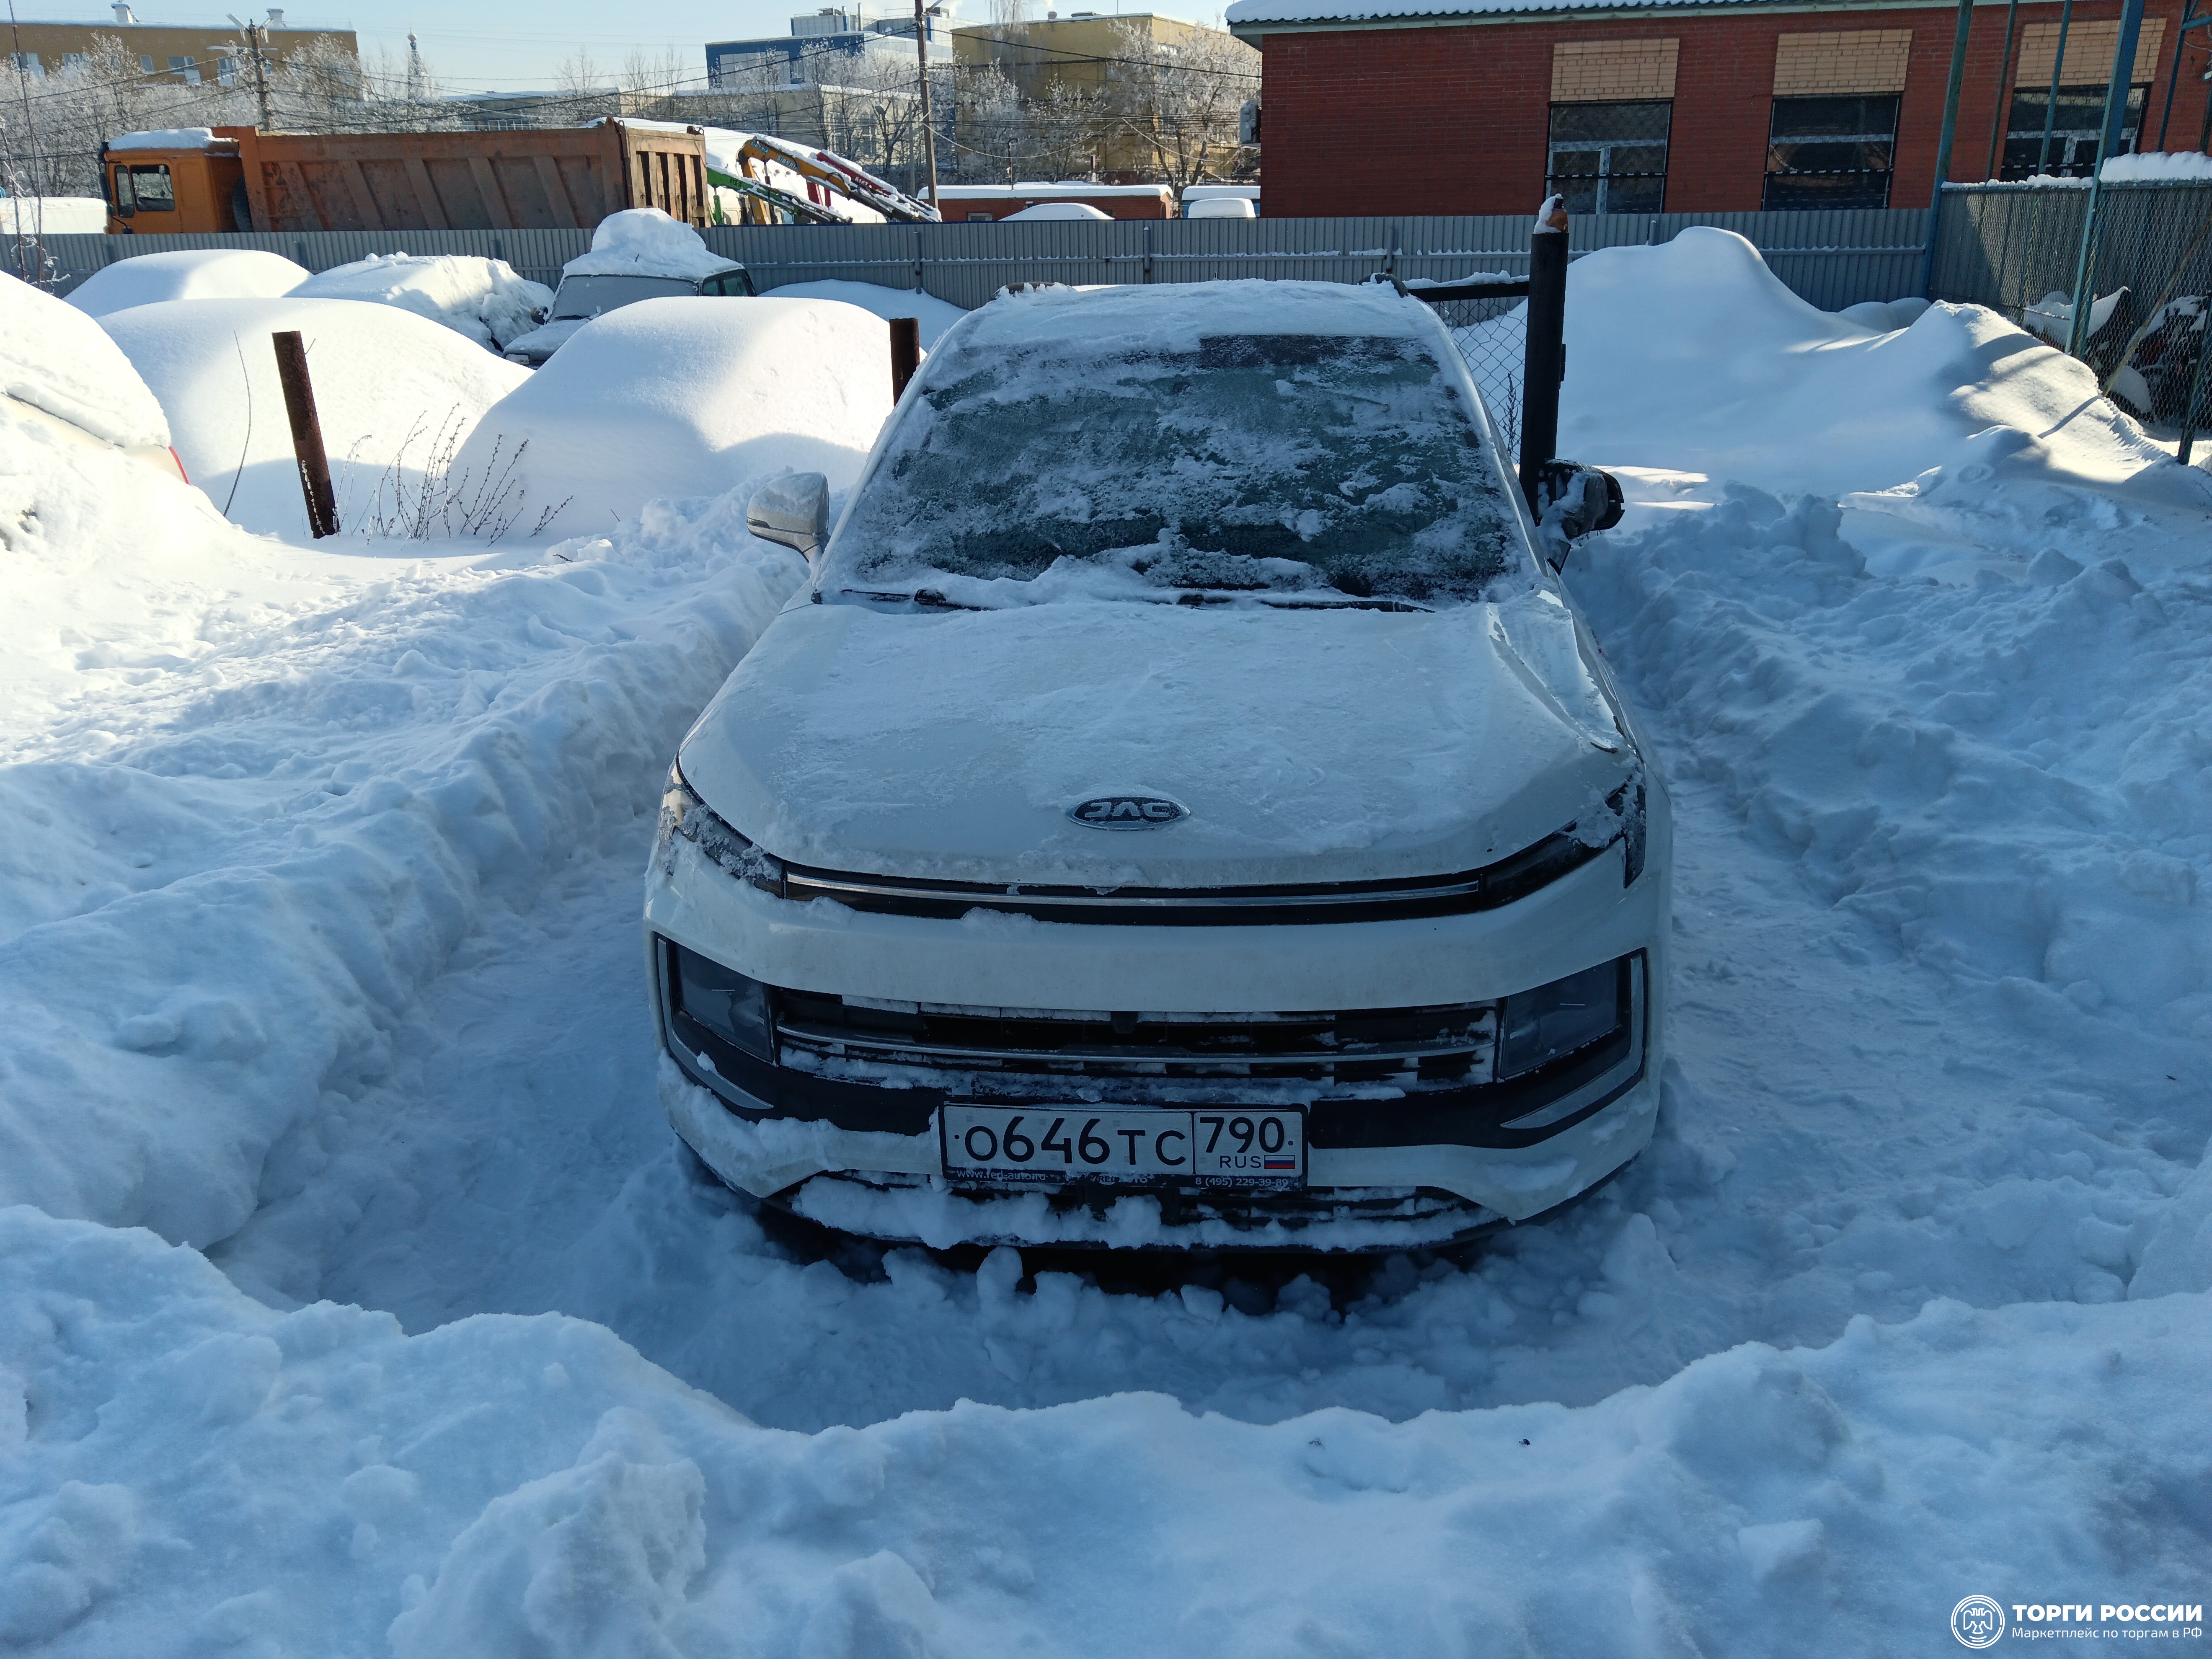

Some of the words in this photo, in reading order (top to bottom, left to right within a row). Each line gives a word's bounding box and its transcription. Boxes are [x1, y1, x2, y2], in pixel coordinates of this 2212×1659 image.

[1085, 801, 1170, 817] JAC
[1199, 1116, 1284, 1153] 790
[1220, 1155, 1261, 1168] RUS
[1205, 1177, 1233, 1187] (495)
